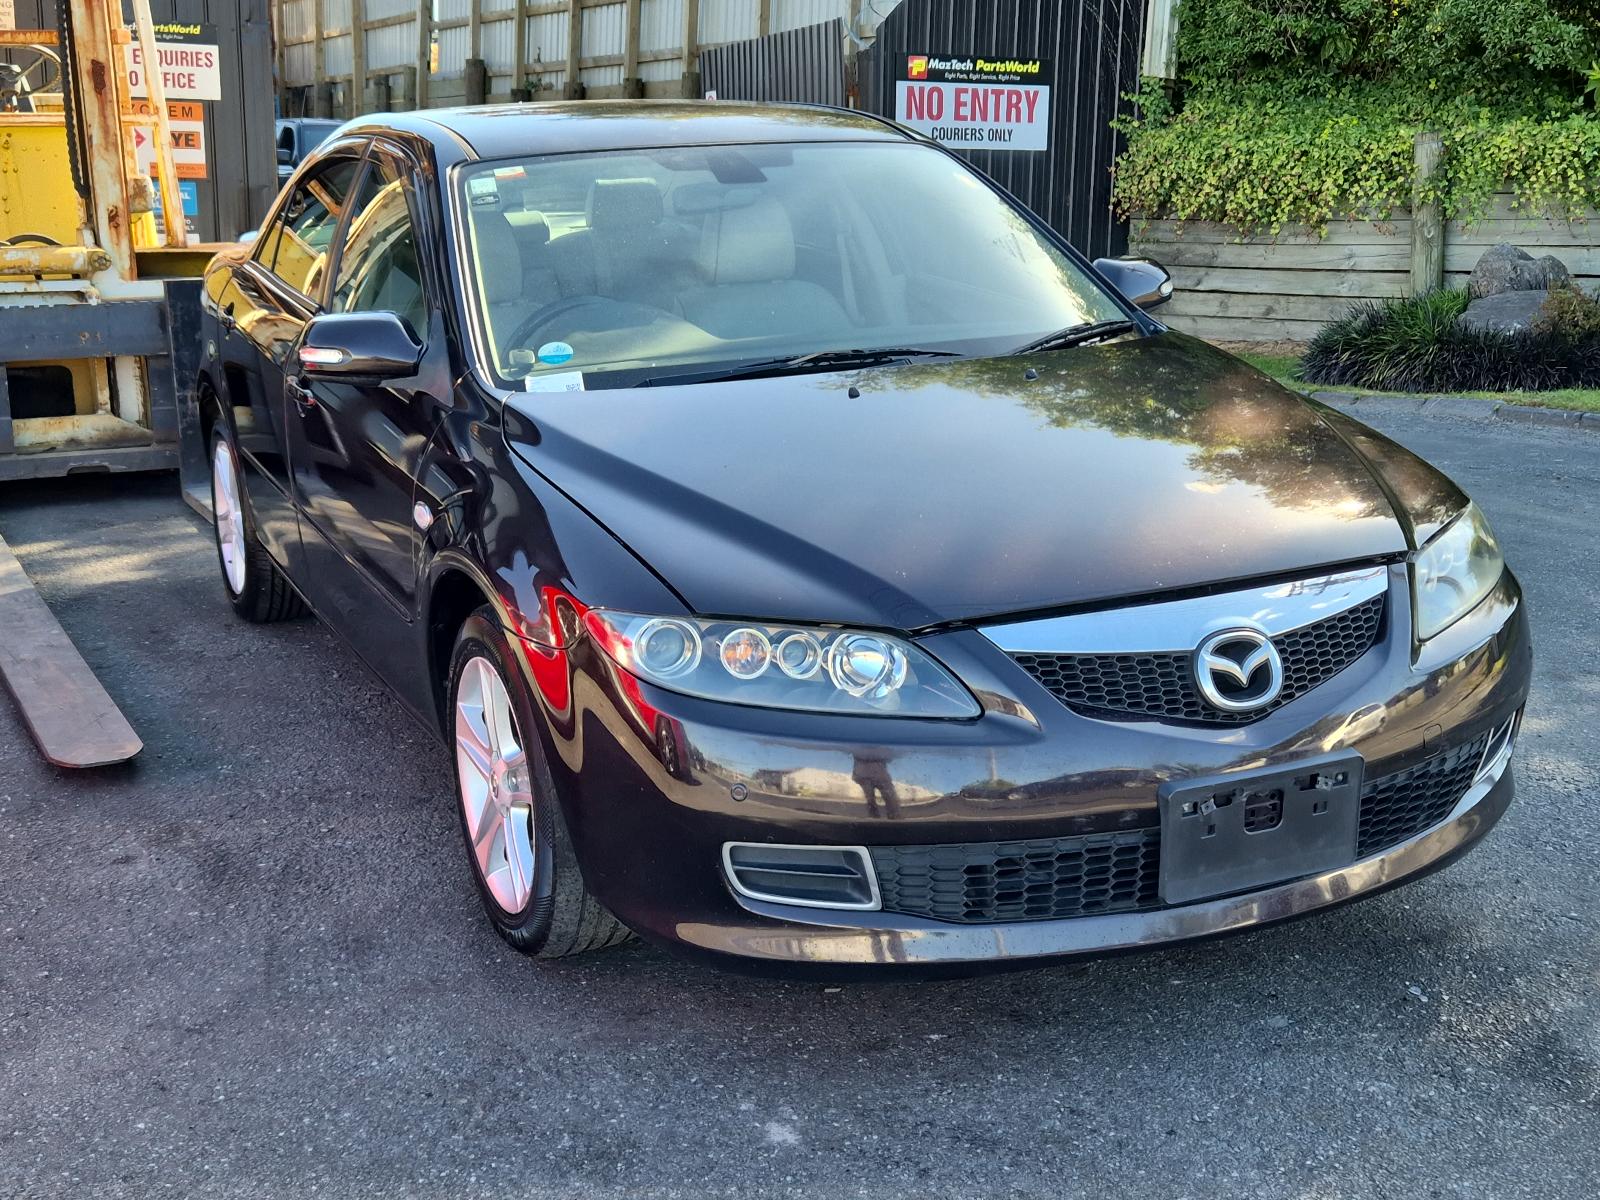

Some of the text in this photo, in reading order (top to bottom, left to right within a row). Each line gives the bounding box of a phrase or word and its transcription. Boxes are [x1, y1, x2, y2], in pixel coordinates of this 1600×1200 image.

[928, 58, 1040, 72] MazTech PartsWorld
[906, 86, 1039, 123] NO ENTRY
[931, 127, 1012, 142] COURIERS ONLY
